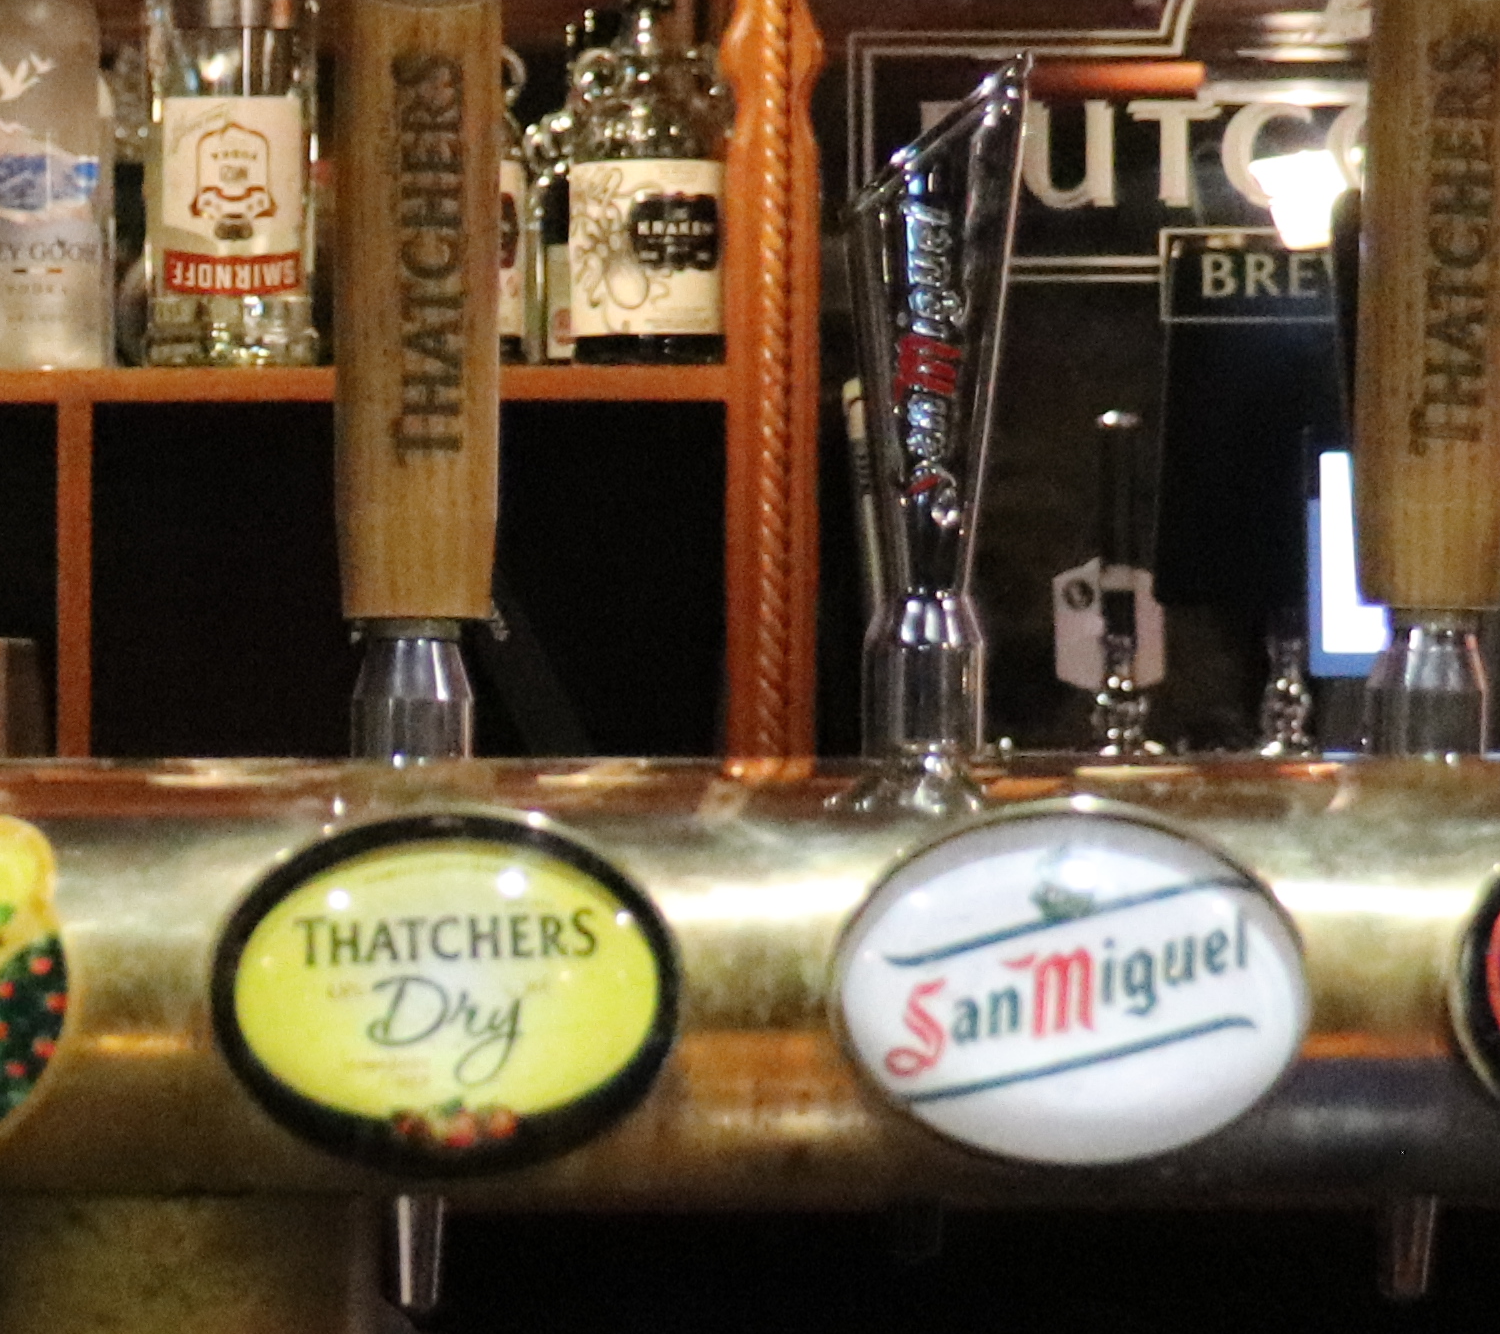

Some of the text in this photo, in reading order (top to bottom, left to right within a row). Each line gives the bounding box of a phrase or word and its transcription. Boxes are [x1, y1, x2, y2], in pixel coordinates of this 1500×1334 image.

[170, 257, 297, 291] SMIRNOFF
[294, 906, 600, 968] THATCHERS
[366, 973, 529, 1090] Dry
[884, 904, 1250, 1079] San Miguel
